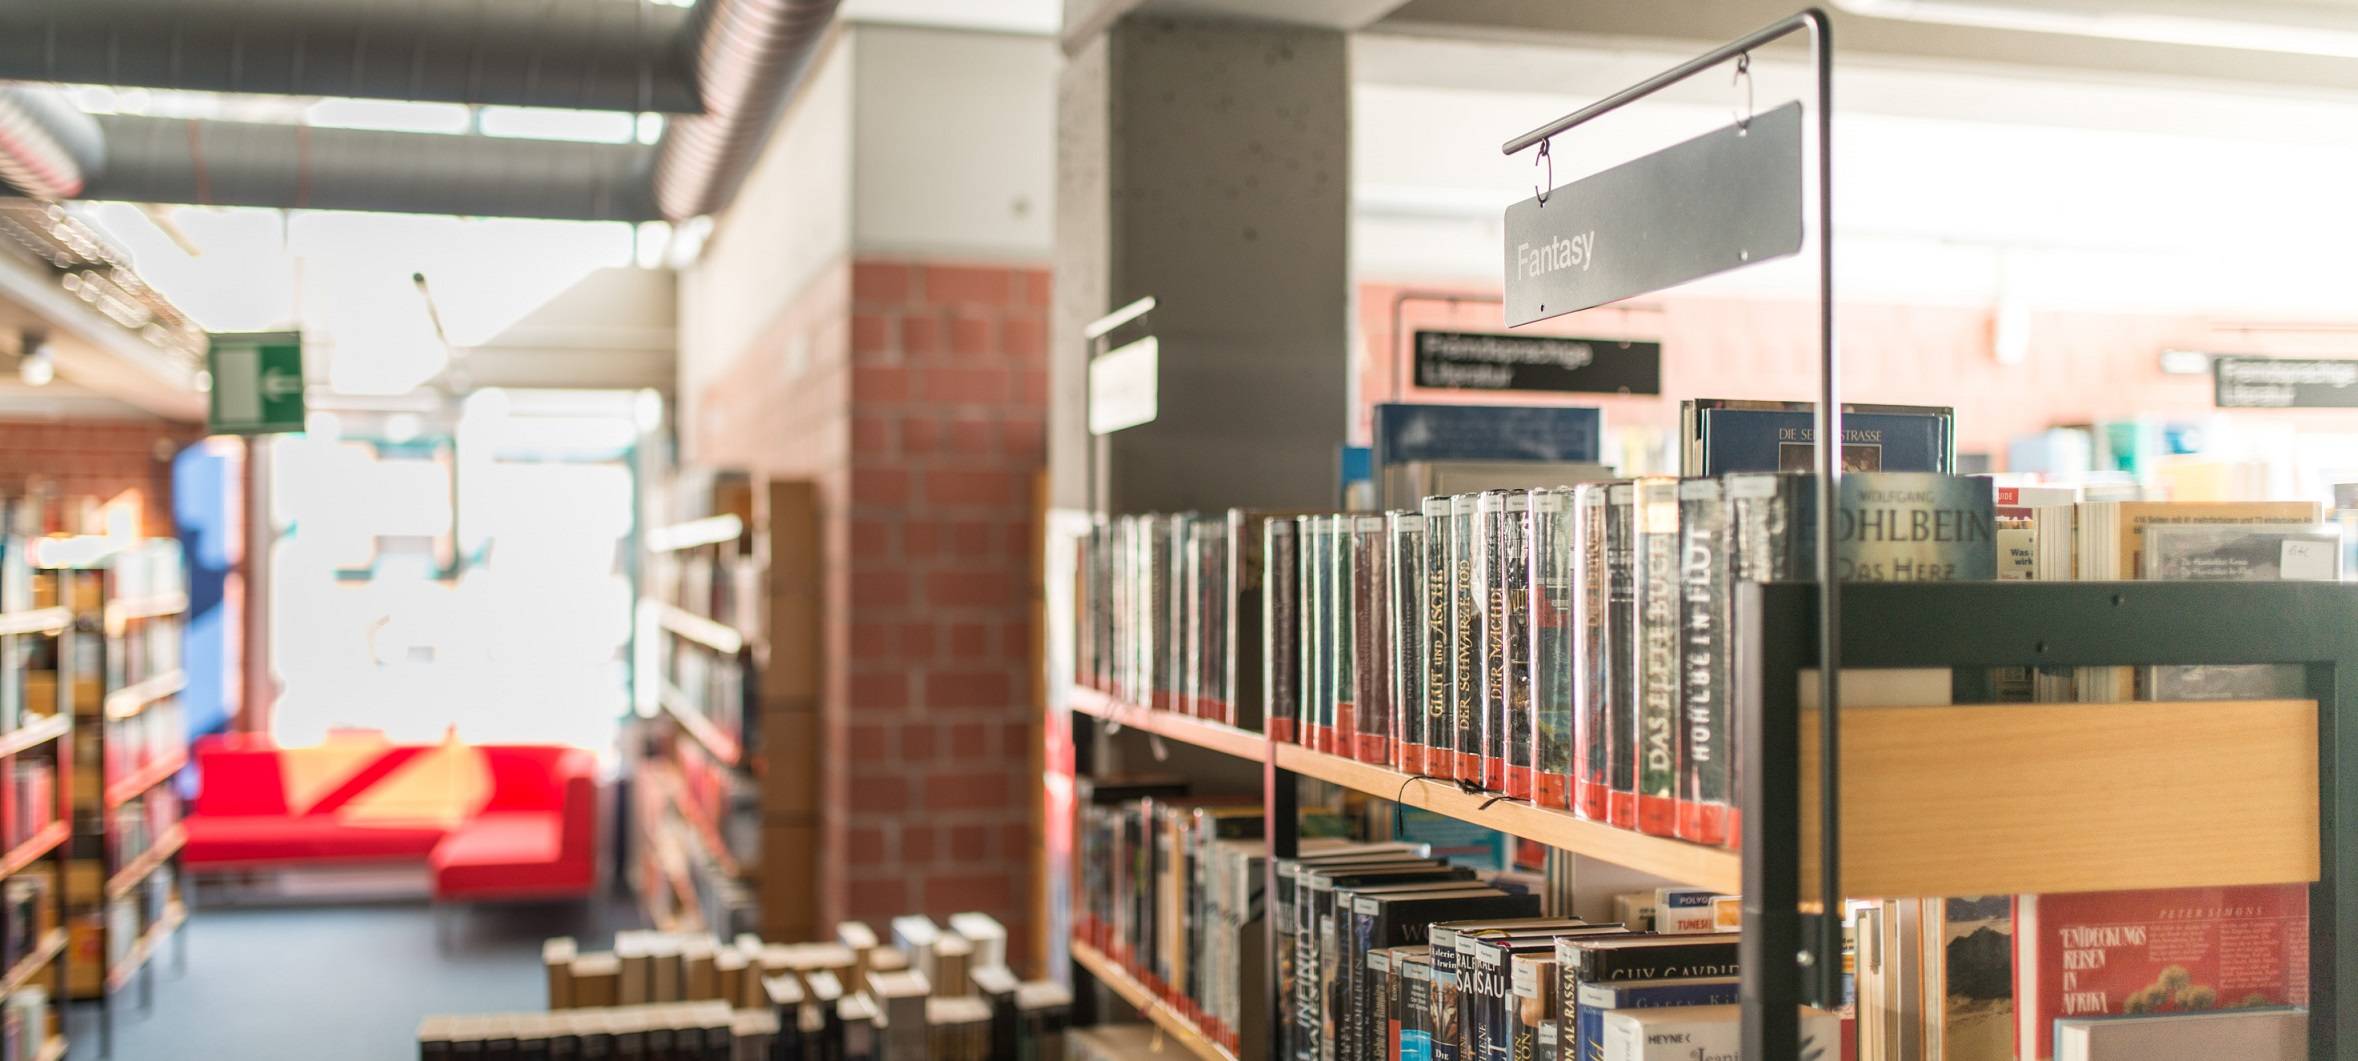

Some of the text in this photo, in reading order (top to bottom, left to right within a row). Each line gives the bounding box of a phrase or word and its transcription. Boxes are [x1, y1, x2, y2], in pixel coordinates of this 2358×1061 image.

[1517, 230, 1595, 280] Fantasy
[1779, 428, 1796, 440] DIE
[1858, 490, 1936, 503] WOLFGANG
[1839, 509, 1990, 542] OHLBEIN
[1647, 533, 1671, 621] BUCH
[1688, 522, 1712, 602] FLUT
[1430, 569, 1447, 642] ASCHE
[1458, 560, 1472, 731] DER SCHWARZE TOD
[1430, 668, 1444, 718] GLUT
[1490, 663, 1504, 701] DER
[1690, 614, 1712, 761] HOHLBEIN
[1647, 716, 1671, 771] DAS
[2159, 906, 2262, 920] PETER SIMONS
[1611, 968, 1655, 980] GUY
[2063, 949, 2106, 970] REISEN
[2063, 970, 2077, 992] IN
[1435, 1048, 1449, 1060] DIE
[1649, 1031, 1683, 1043] HEYNE
